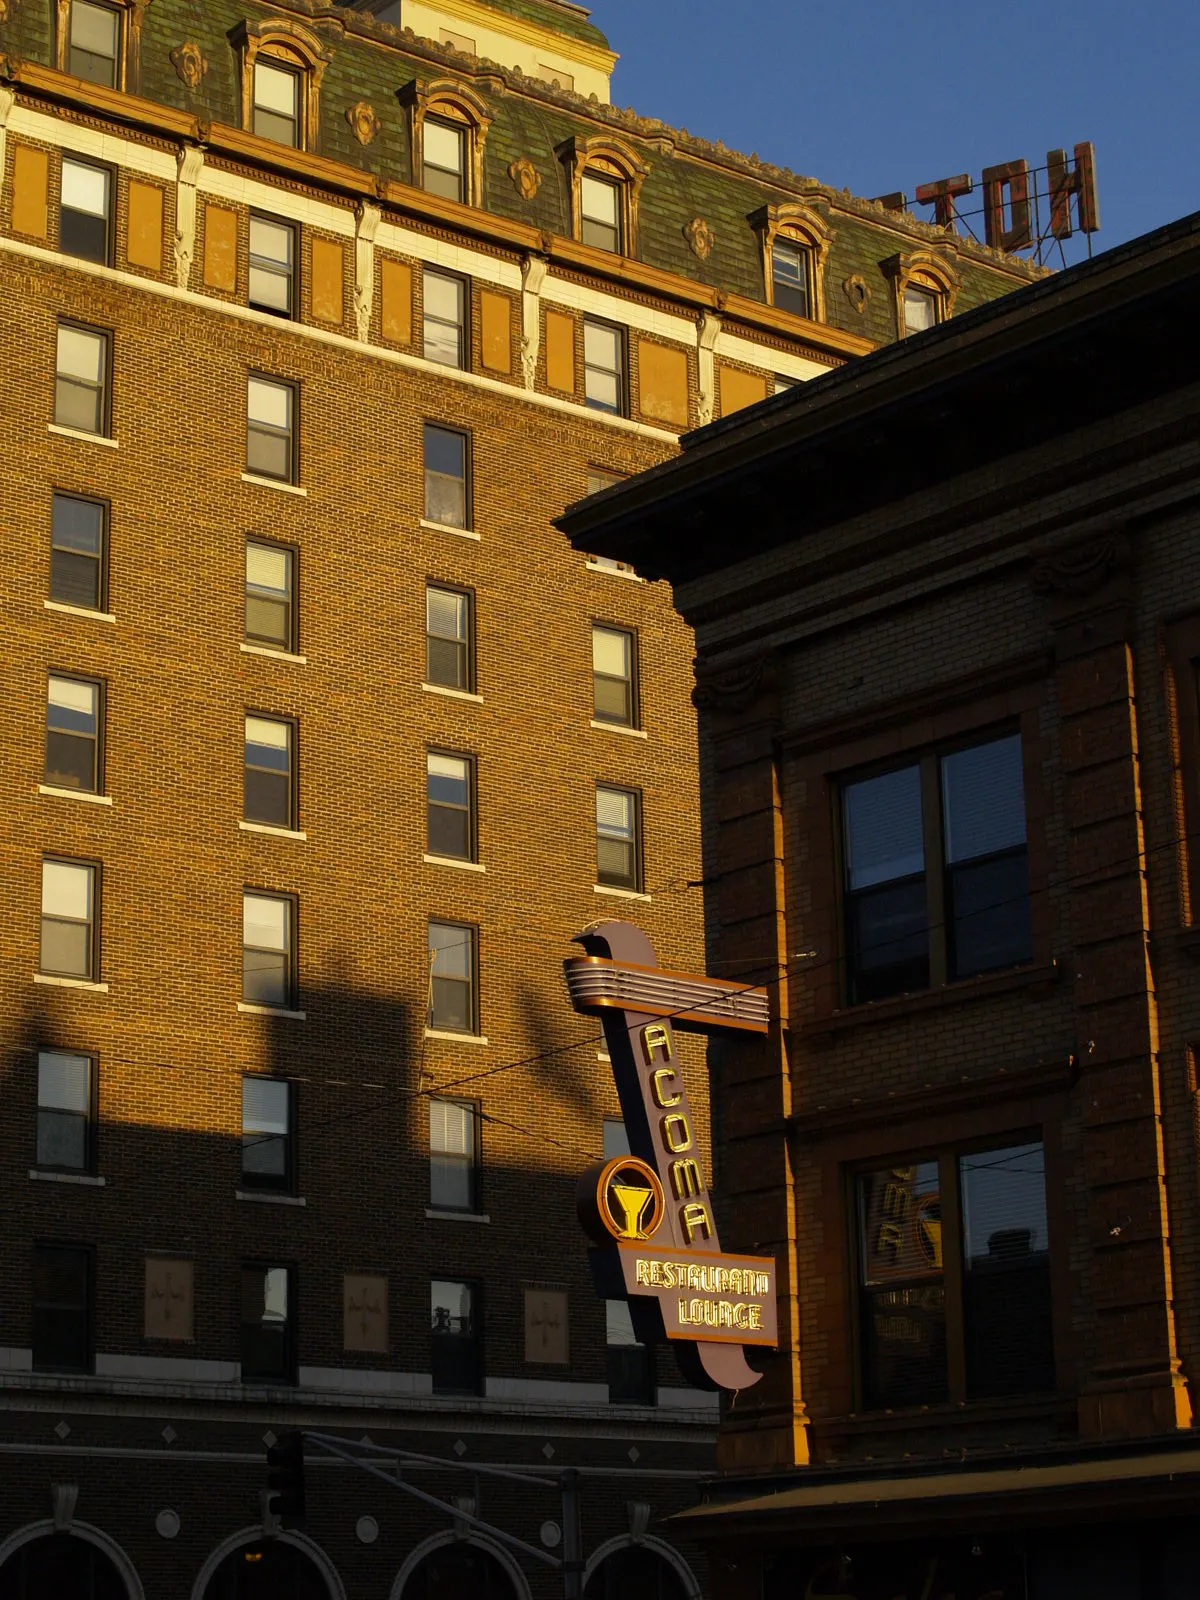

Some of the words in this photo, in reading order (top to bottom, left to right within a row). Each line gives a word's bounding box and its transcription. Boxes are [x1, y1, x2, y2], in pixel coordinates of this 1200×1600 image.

[643, 1024, 713, 1245] ACOMA
[635, 1259, 770, 1296] RESTAURANT
[678, 1298, 764, 1330] LOUNGE
